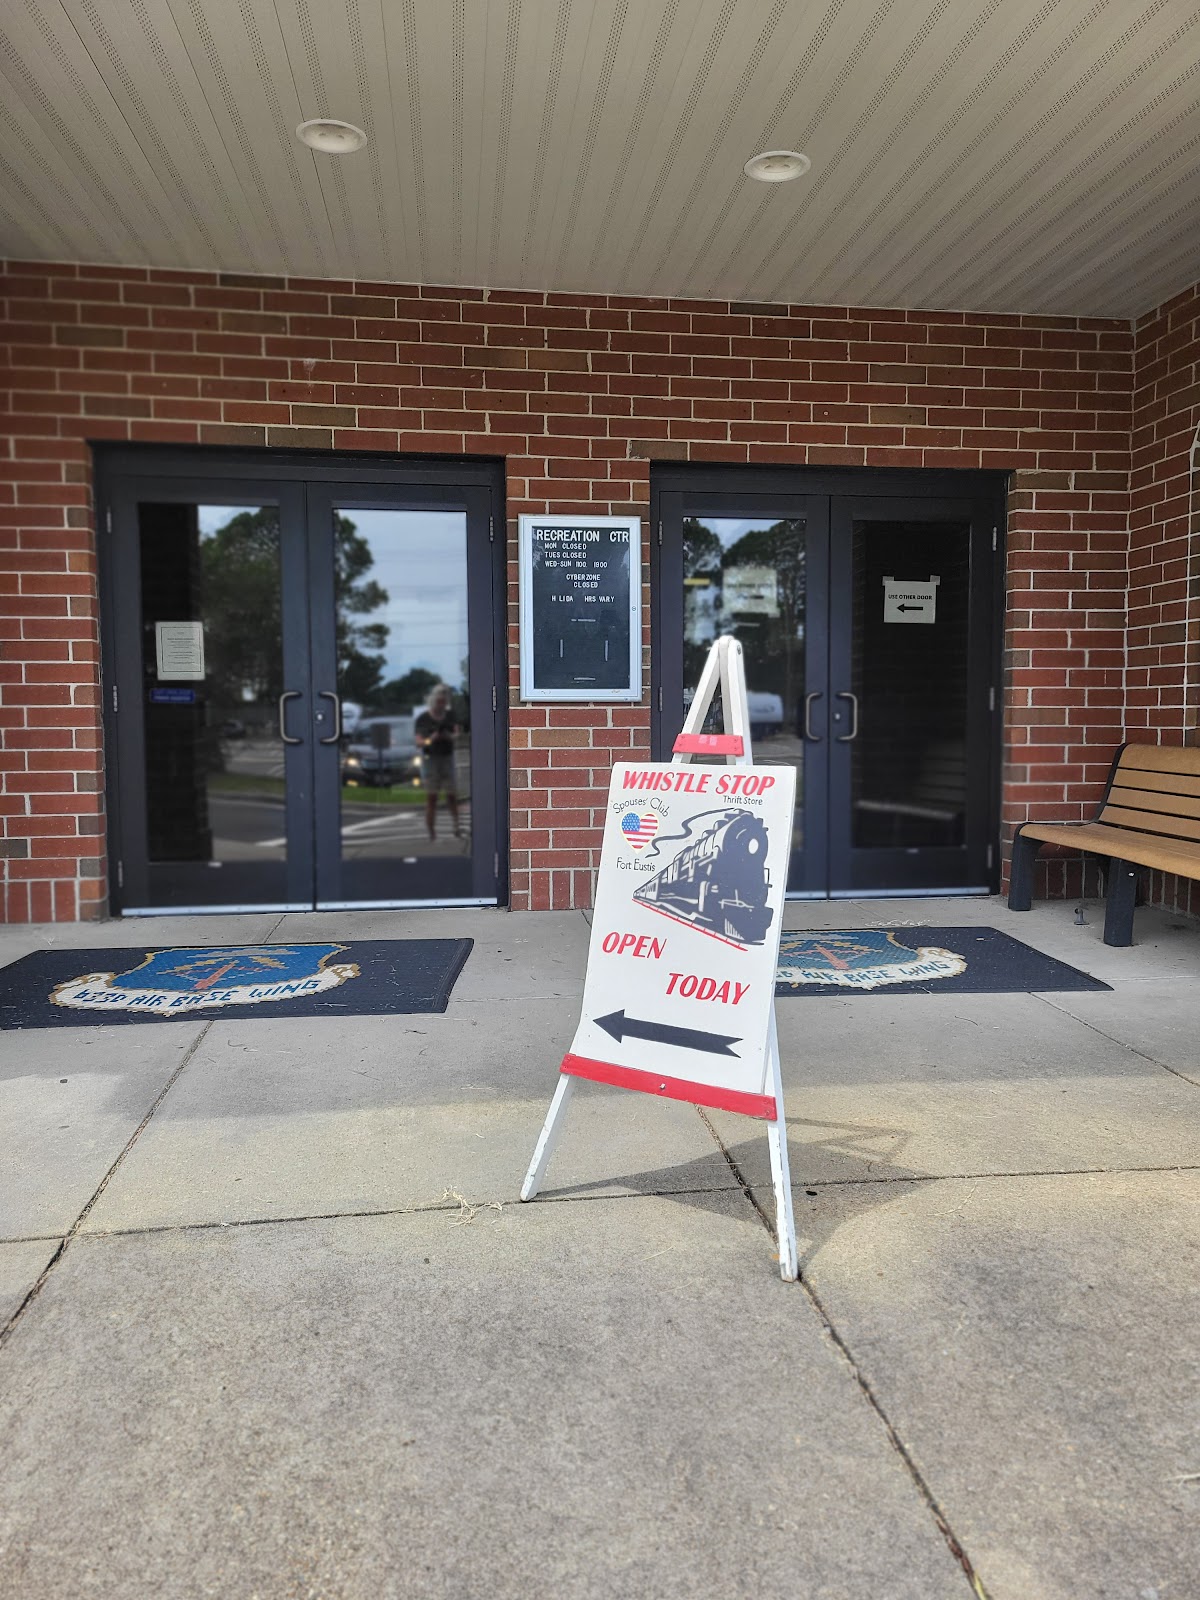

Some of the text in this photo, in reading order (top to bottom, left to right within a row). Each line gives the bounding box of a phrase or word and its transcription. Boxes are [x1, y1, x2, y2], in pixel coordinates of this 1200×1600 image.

[536, 529, 629, 543] RECREATION CTR
[562, 542, 587, 550] CLOSED
[562, 551, 587, 559] CLOSED
[545, 560, 572, 568] WED-SUN
[584, 595, 596, 603] HRS
[598, 595, 615, 603] VARY
[622, 770, 776, 796] WHISTLE STOP
[649, 796, 670, 818] Club
[723, 795, 763, 806] Thrift Store
[616, 856, 656, 872] Fort Eustis
[602, 931, 667, 959] OPEN
[843, 970, 892, 982] BASE
[899, 960, 950, 976] WING
[127, 993, 168, 1006] AIR
[168, 990, 240, 1007] BASE
[248, 979, 322, 998] WING
[665, 972, 750, 1005] TODAY
